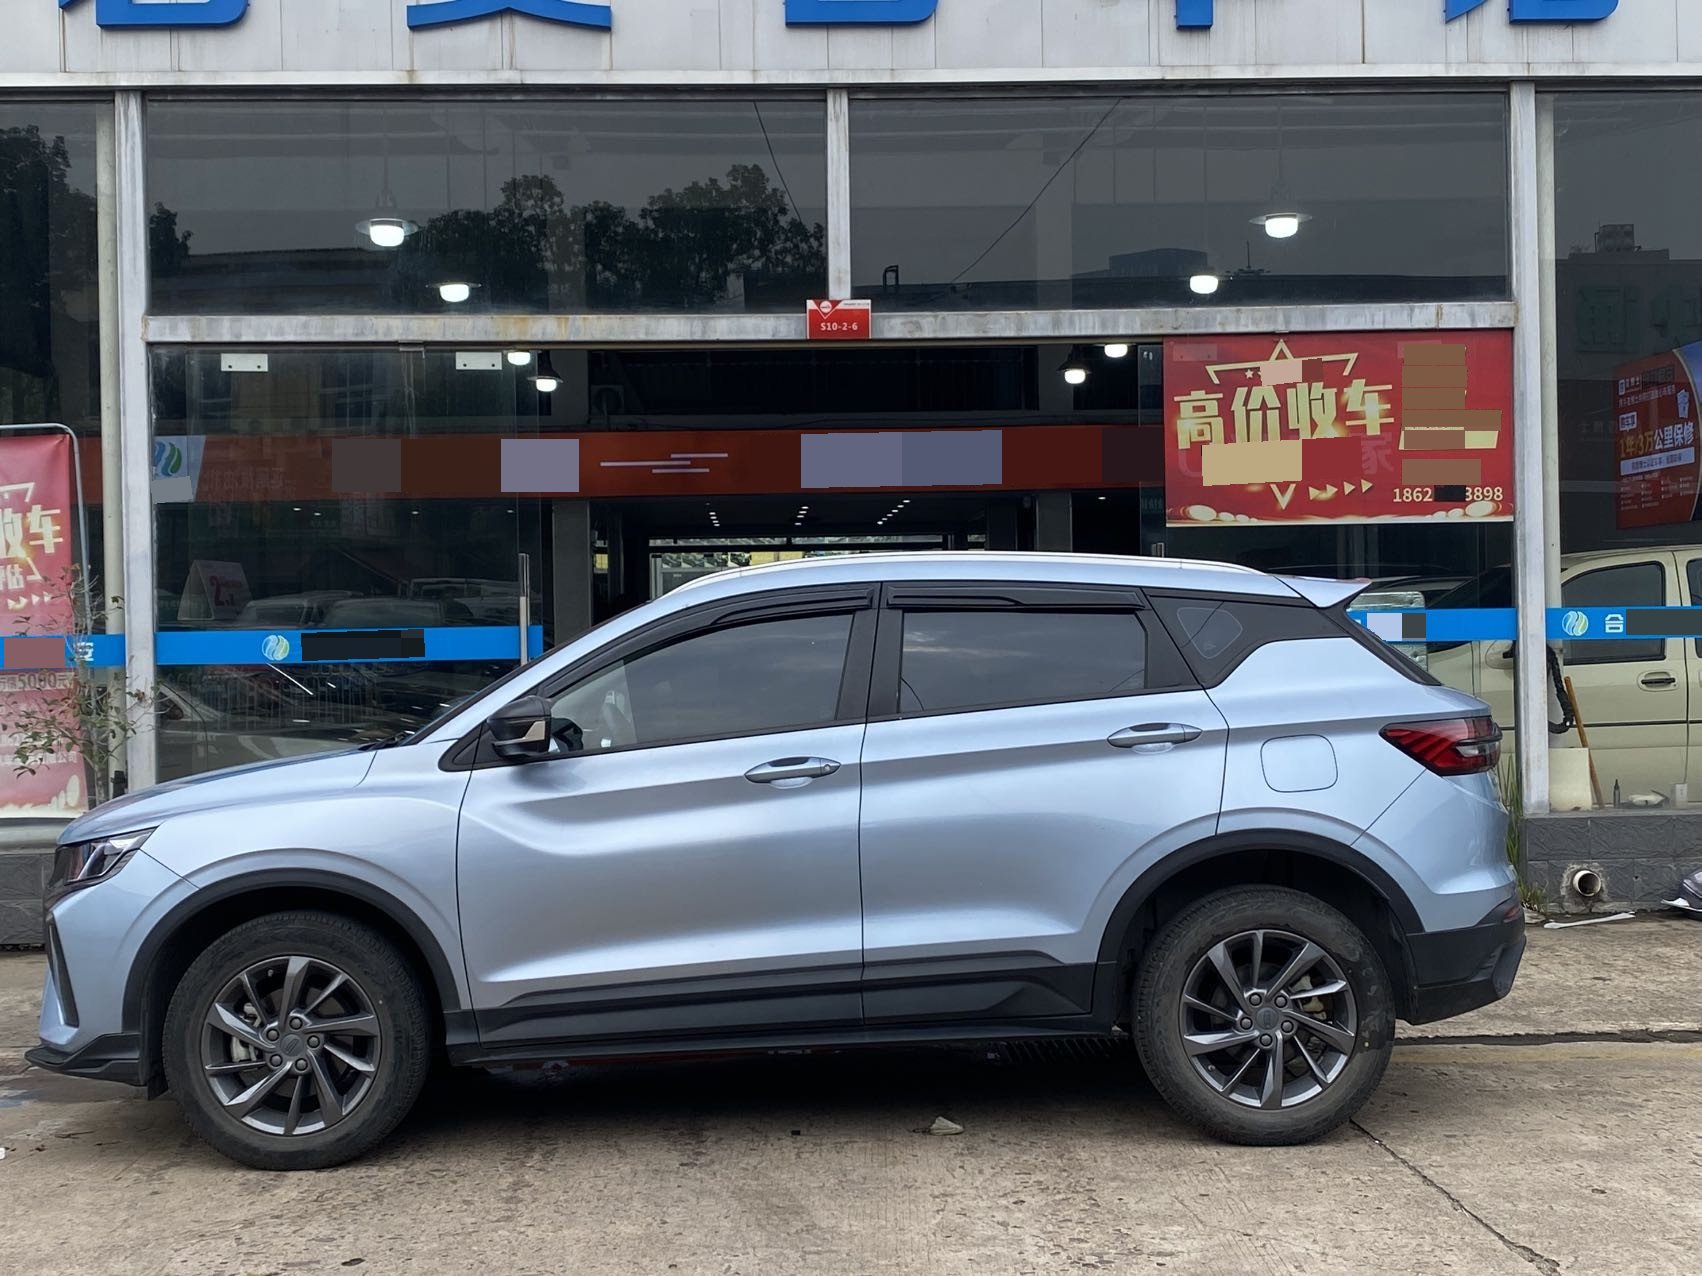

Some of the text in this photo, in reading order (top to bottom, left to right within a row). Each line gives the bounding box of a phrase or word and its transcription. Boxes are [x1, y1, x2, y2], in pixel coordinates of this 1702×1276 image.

[820, 322, 858, 331] S10-2-6
[1173, 378, 1395, 450] 高价收车
[1393, 487, 1503, 502] 18623898
